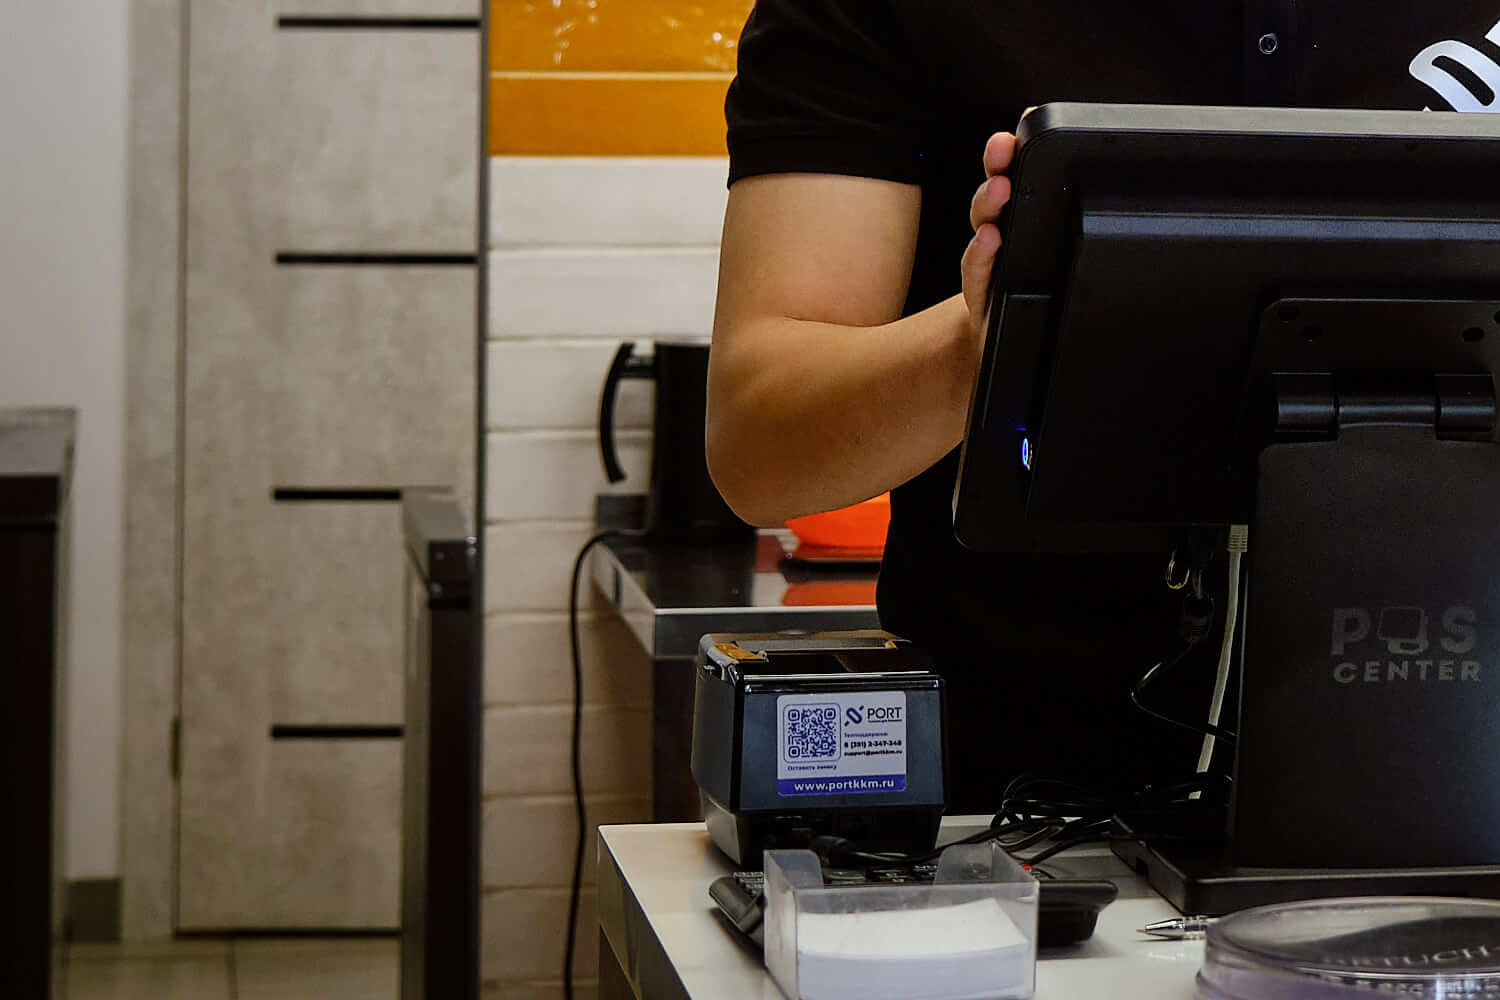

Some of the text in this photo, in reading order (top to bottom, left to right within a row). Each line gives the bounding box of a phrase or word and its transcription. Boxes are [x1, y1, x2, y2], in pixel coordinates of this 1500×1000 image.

[1333, 660, 1482, 684] CENTER
[867, 706, 902, 720] PORT
[794, 779, 895, 792] www.portkkm.ru
